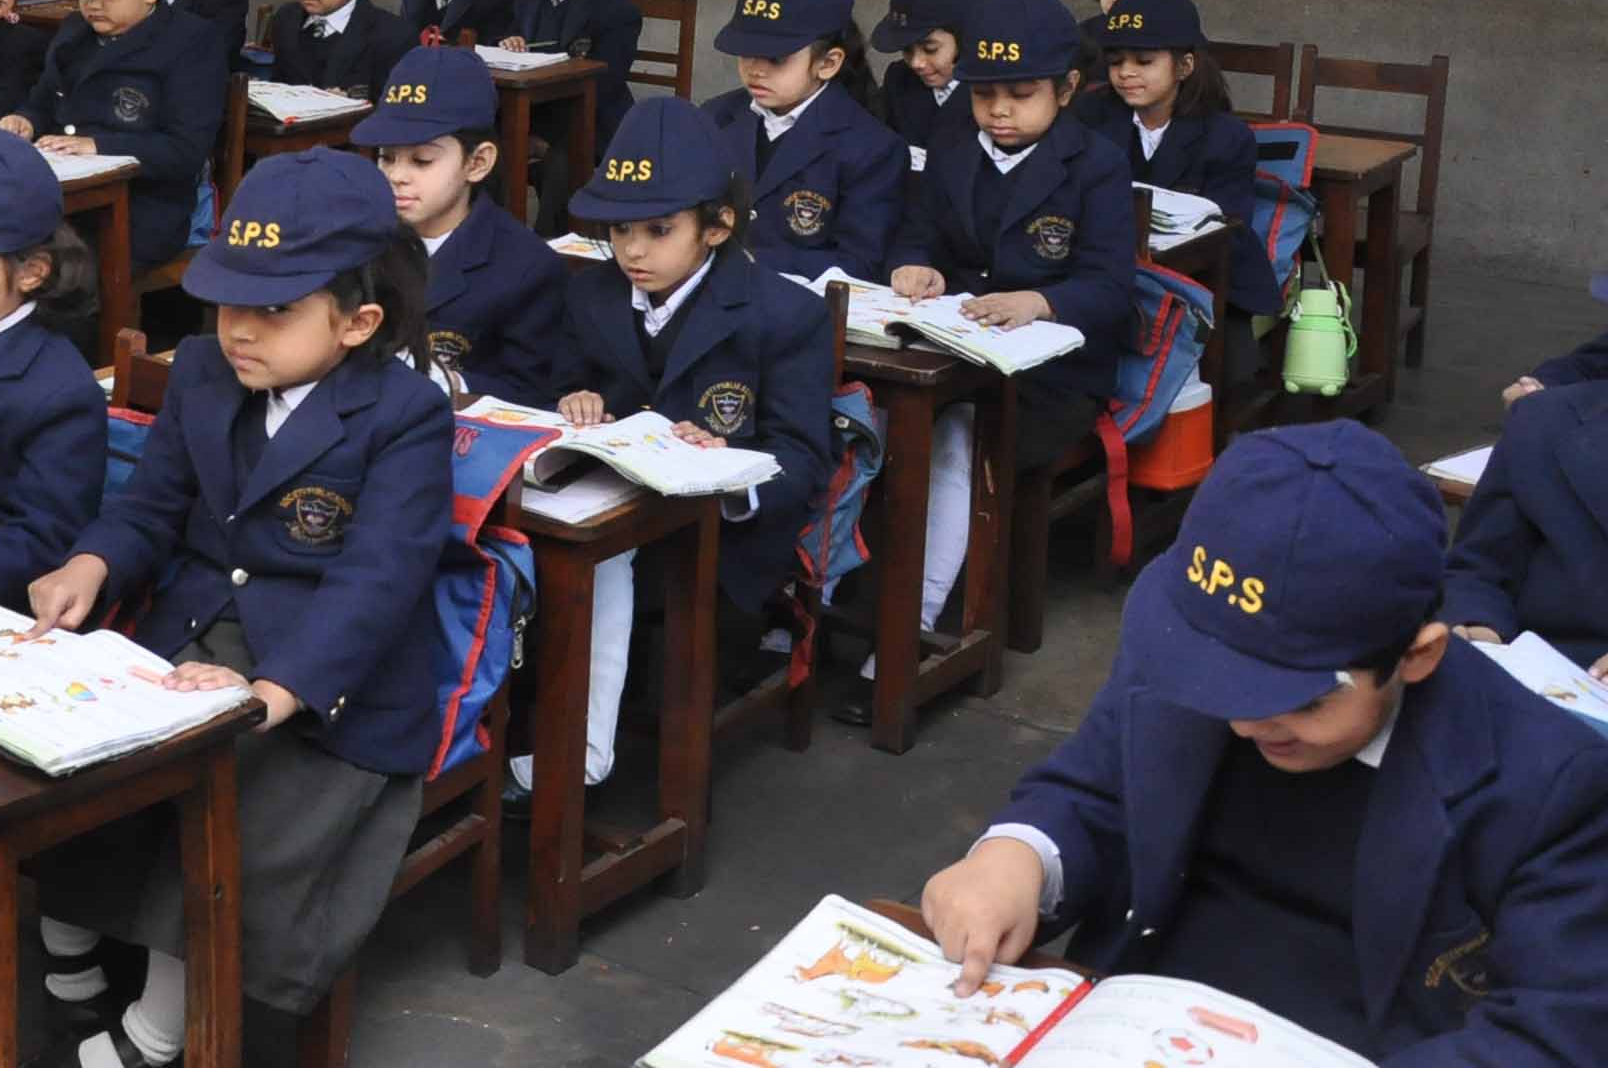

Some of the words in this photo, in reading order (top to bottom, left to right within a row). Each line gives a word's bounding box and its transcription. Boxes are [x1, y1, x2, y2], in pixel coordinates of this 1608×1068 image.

[1106, 13, 1143, 30] S.P.S
[977, 40, 1021, 61] S.P.S
[385, 84, 427, 106] S.P.S
[605, 158, 652, 182] S.P.S
[227, 219, 281, 248] S.P.S
[1187, 544, 1265, 614] S.P.S
